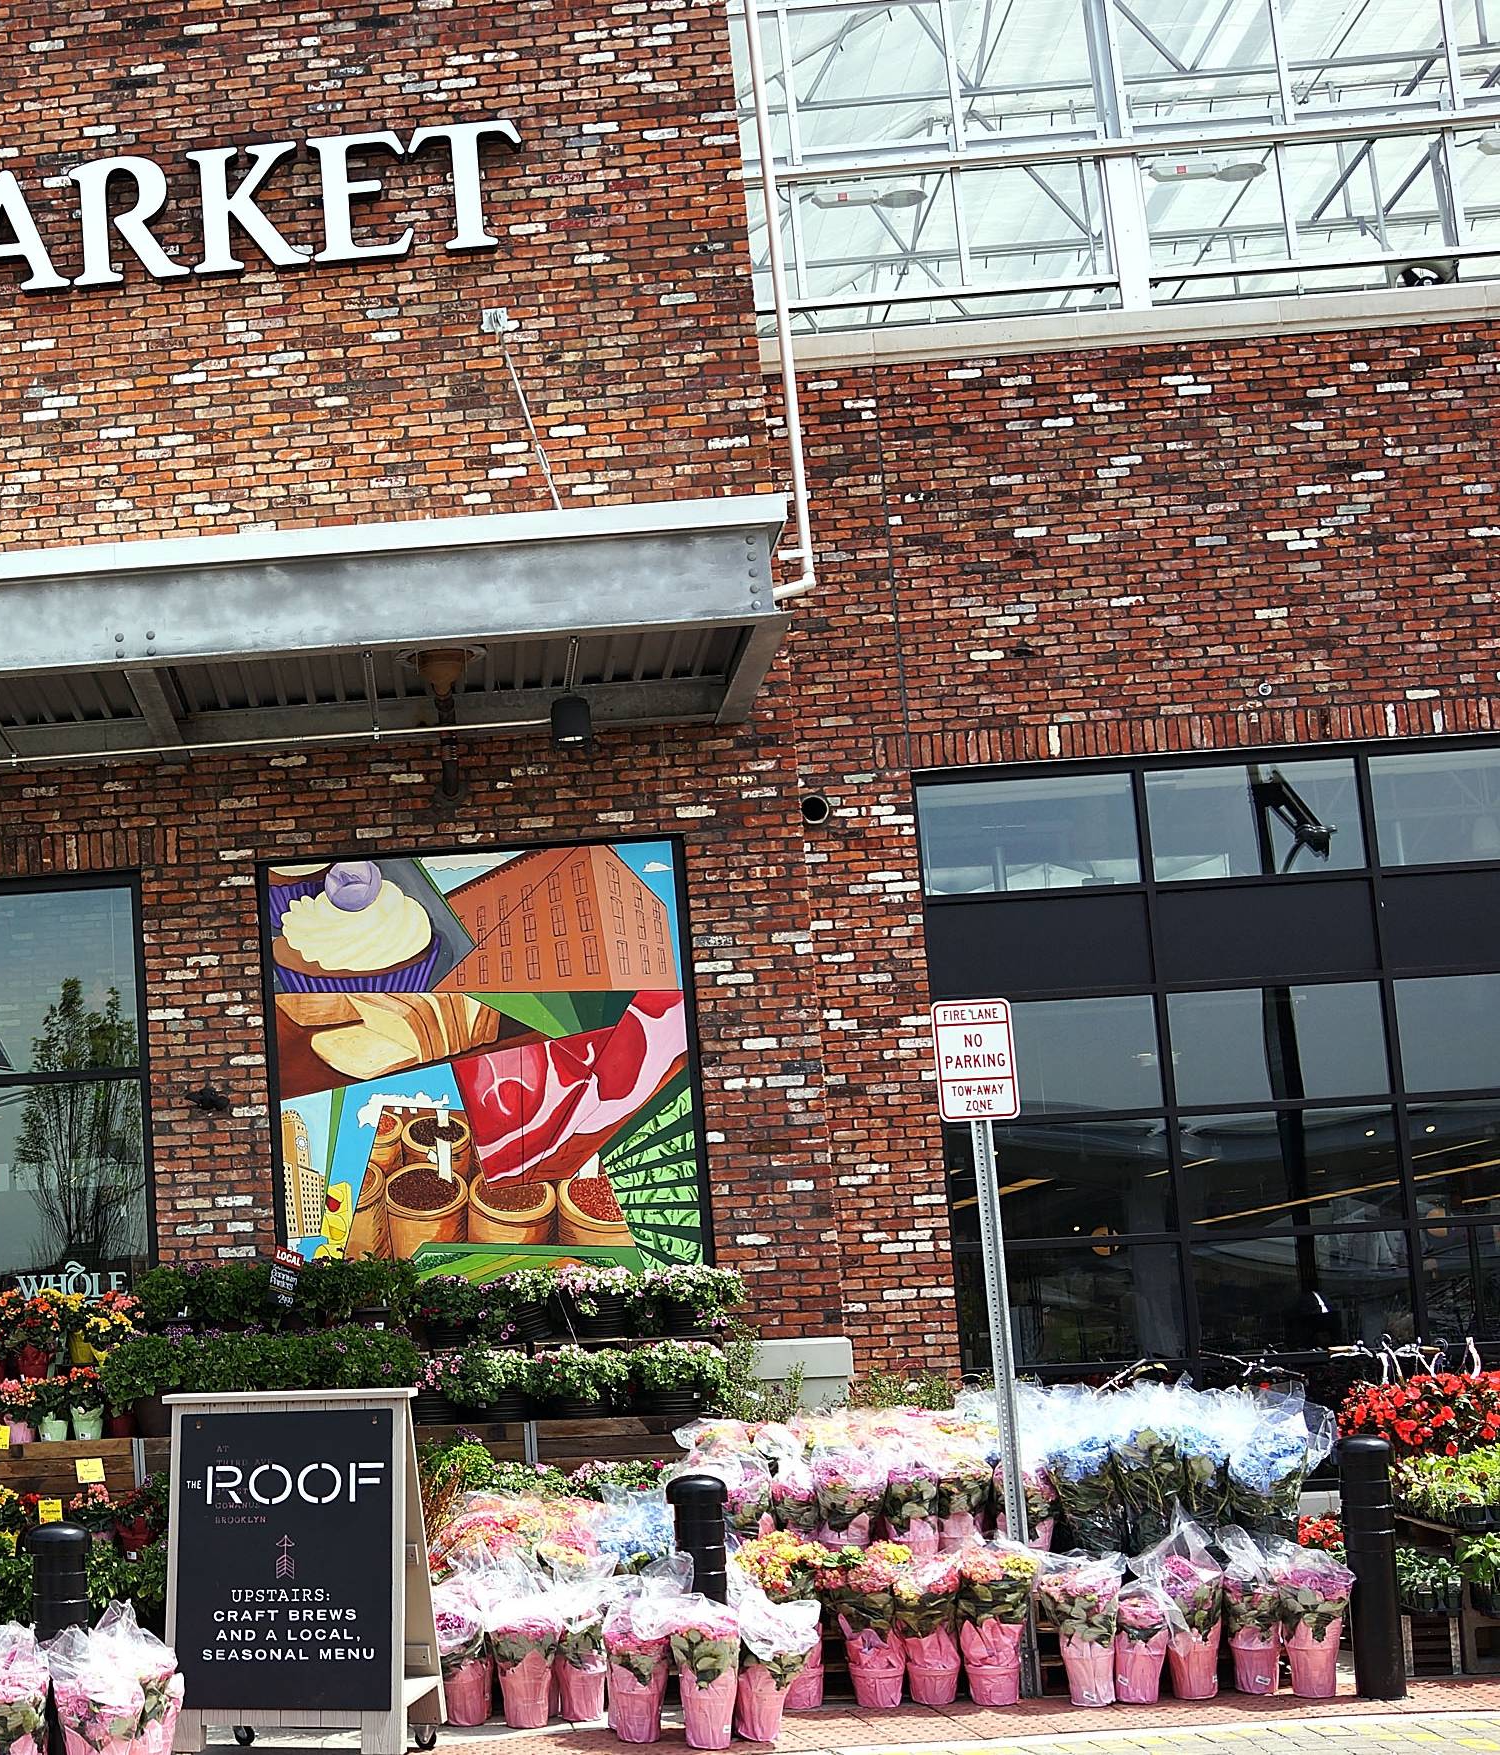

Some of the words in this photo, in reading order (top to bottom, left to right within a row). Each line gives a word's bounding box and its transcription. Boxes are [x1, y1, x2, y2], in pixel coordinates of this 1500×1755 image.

[943, 1009, 966, 1021] FIRE
[970, 1007, 999, 1020] LANE
[963, 1033, 983, 1048] NO
[944, 1053, 1006, 1070] PARKING
[951, 1083, 1004, 1097] TOW-AWAY
[965, 1099, 994, 1112] ZONE
[276, 1249, 301, 1267] LOCAL
[15, 1260, 129, 1301] WHOLE
[216, 1445, 229, 1453] AT
[186, 1480, 202, 1490] THE
[206, 1462, 385, 1505] ROOF
[215, 1516, 266, 1524] BROOKLYN
[231, 1588, 331, 1603] UPSTAIRS:
[213, 1610, 279, 1622] CRAFT
[288, 1608, 357, 1622] BREWS
[215, 1629, 256, 1641] AND
[265, 1629, 278, 1641] A
[287, 1628, 361, 1642] LOCAL,
[202, 1648, 310, 1661] SEASONAL
[319, 1648, 375, 1660] MENU
